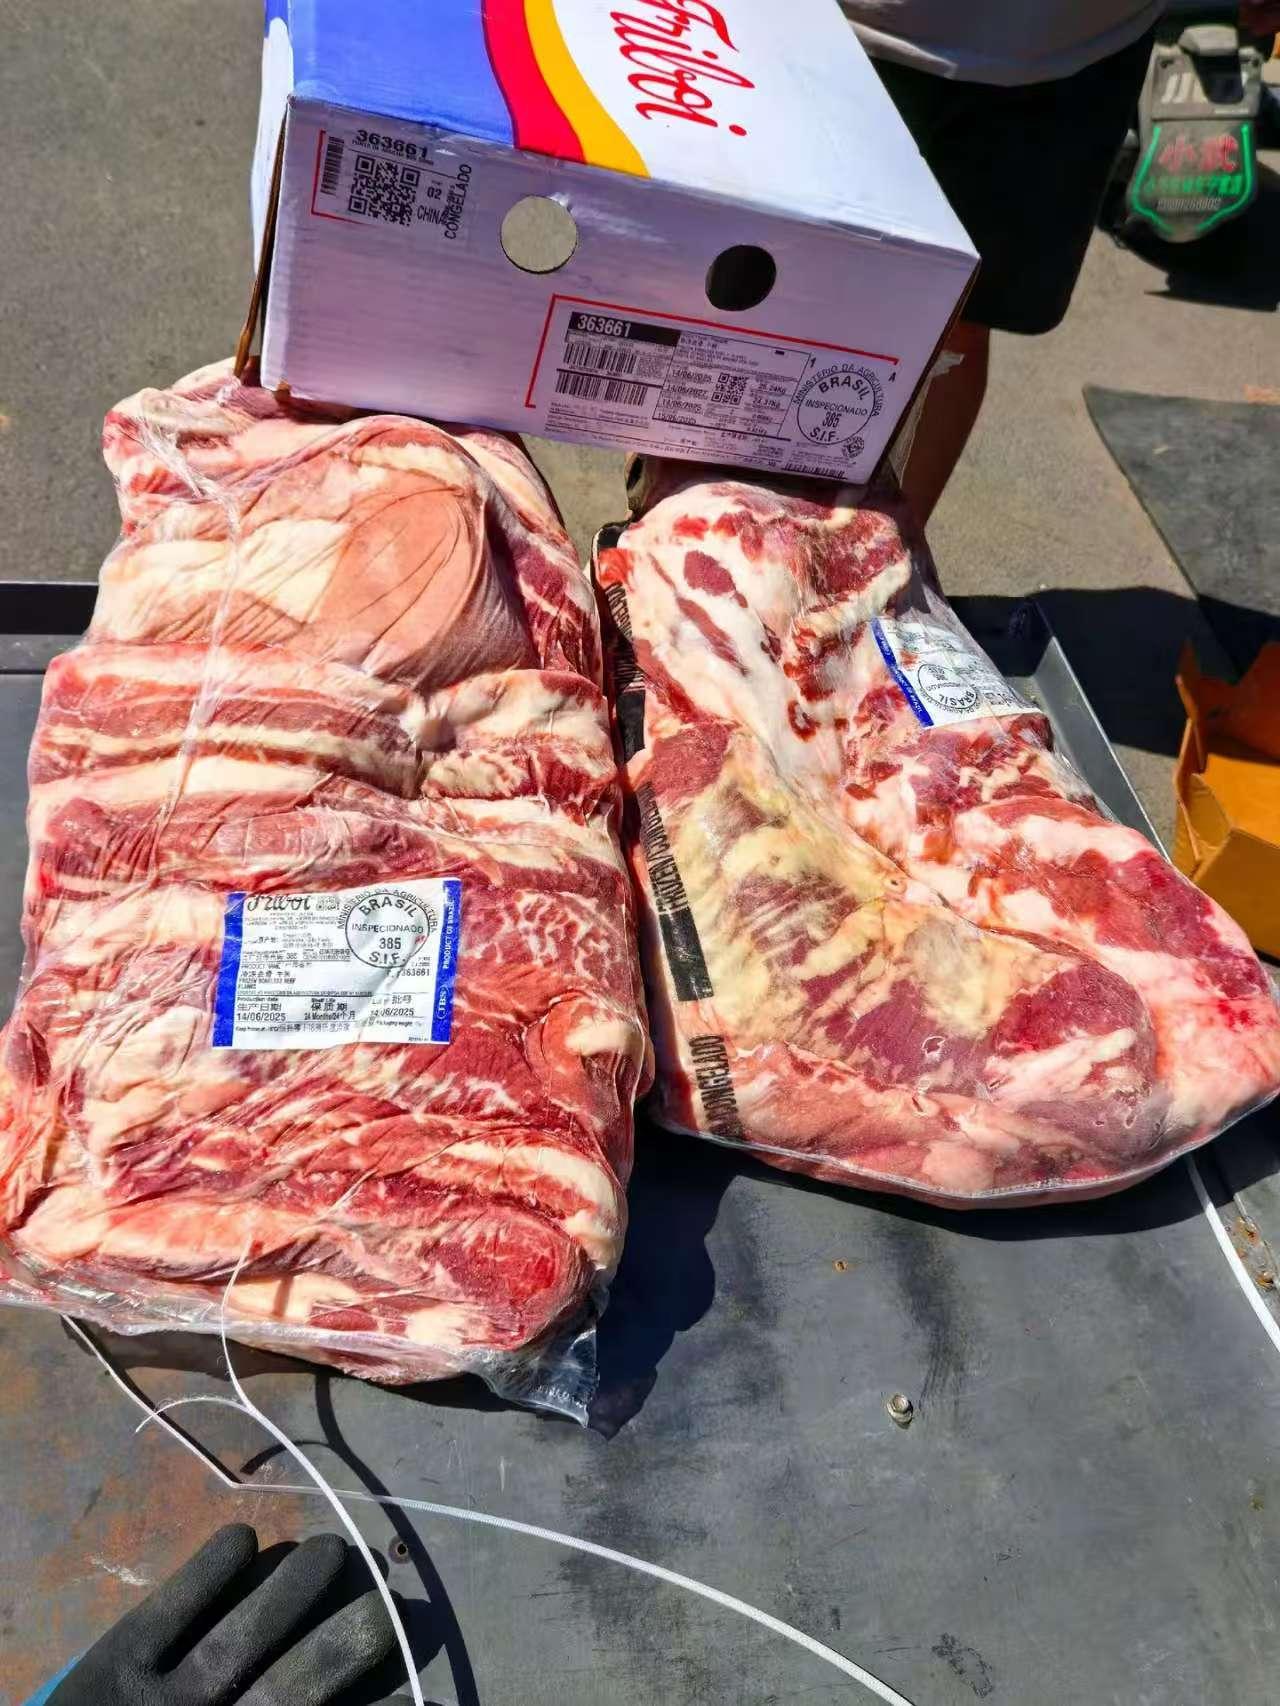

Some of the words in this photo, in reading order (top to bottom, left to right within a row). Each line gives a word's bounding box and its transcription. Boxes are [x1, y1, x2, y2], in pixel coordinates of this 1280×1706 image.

[356, 129, 429, 160] 363661
[444, 164, 473, 240] CONGELADO
[417, 204, 446, 225] CHINA
[577, 314, 633, 338] 363661
[818, 375, 870, 401] BRASIL
[805, 399, 869, 417] INSPECIONADO
[938, 689, 975, 707] BRASIL
[358, 896, 418, 918] BRASIL
[352, 923, 425, 934] INSPECIONADO
[379, 937, 402, 950] 385
[237, 1012, 287, 1021] 14/06/2025
